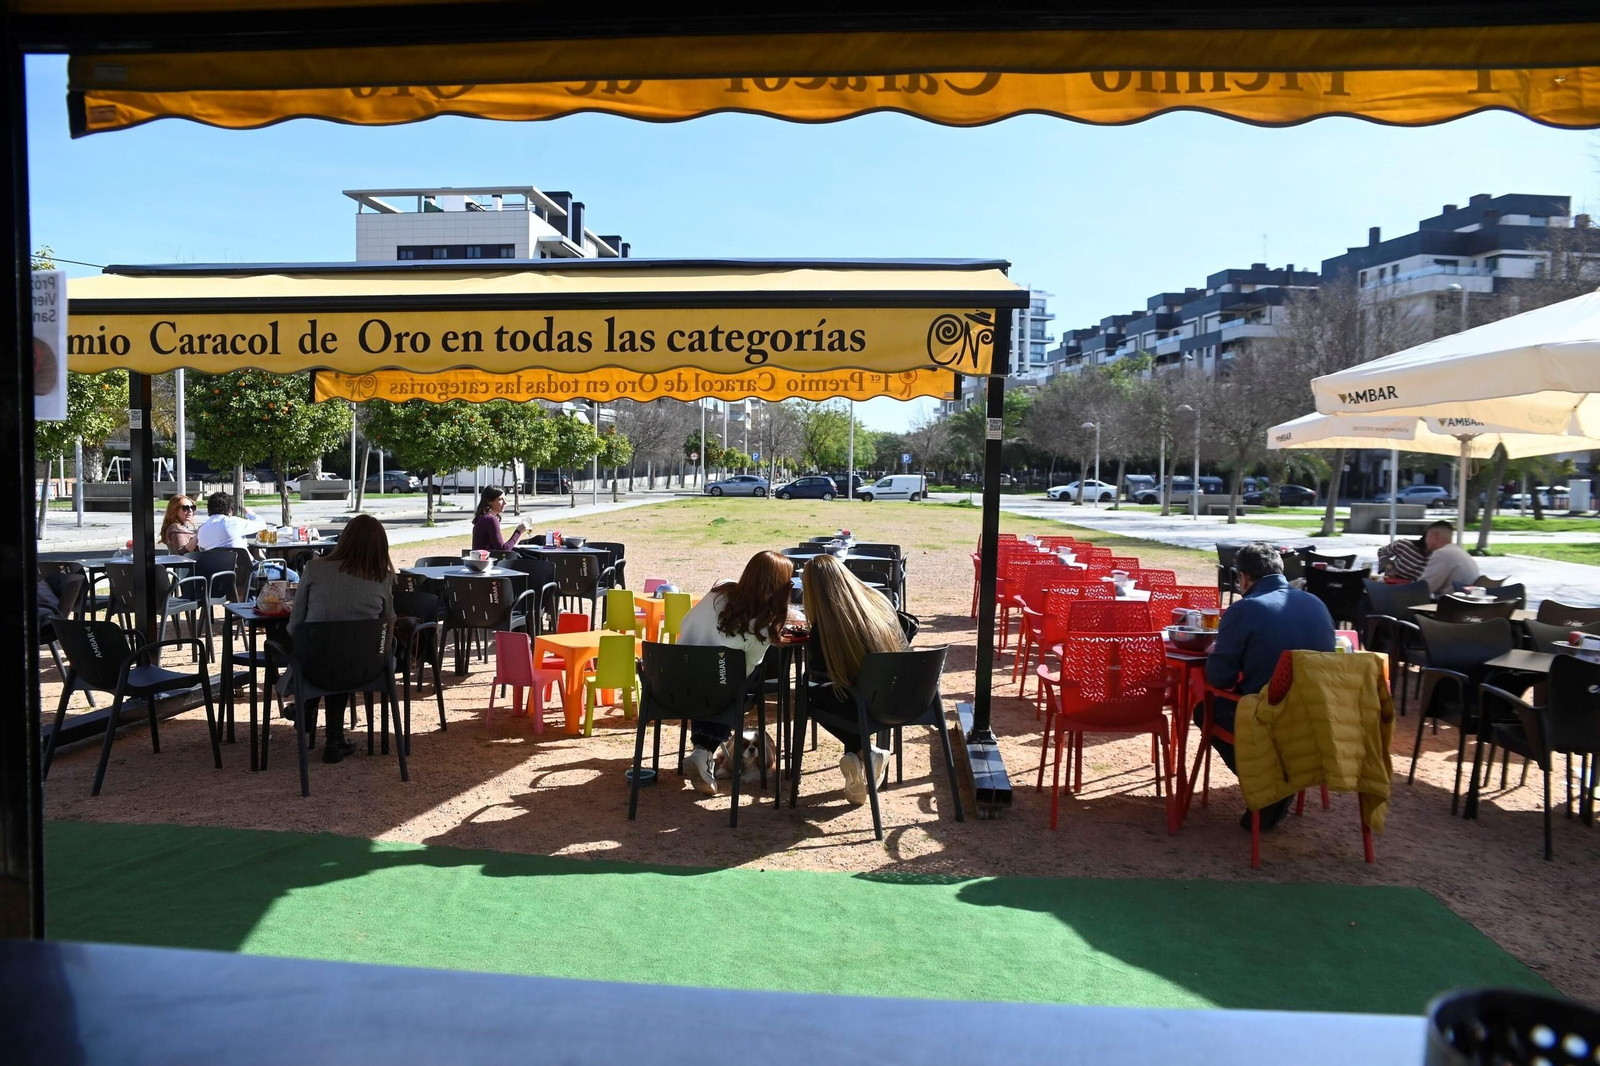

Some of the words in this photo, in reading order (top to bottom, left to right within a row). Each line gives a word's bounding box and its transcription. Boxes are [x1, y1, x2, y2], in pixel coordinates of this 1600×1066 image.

[149, 320, 281, 356] Caracol
[298, 319, 338, 354] de
[358, 318, 431, 354] Oro
[441, 326, 484, 353] en
[495, 316, 593, 353] todas
[604, 316, 656, 353] las
[667, 318, 867, 365] categorías
[1348, 385, 1399, 405] AMBAR
[87, 632, 103, 658] AMBAR
[379, 628, 387, 654] AMBAR
[718, 657, 727, 685] AMBAR
